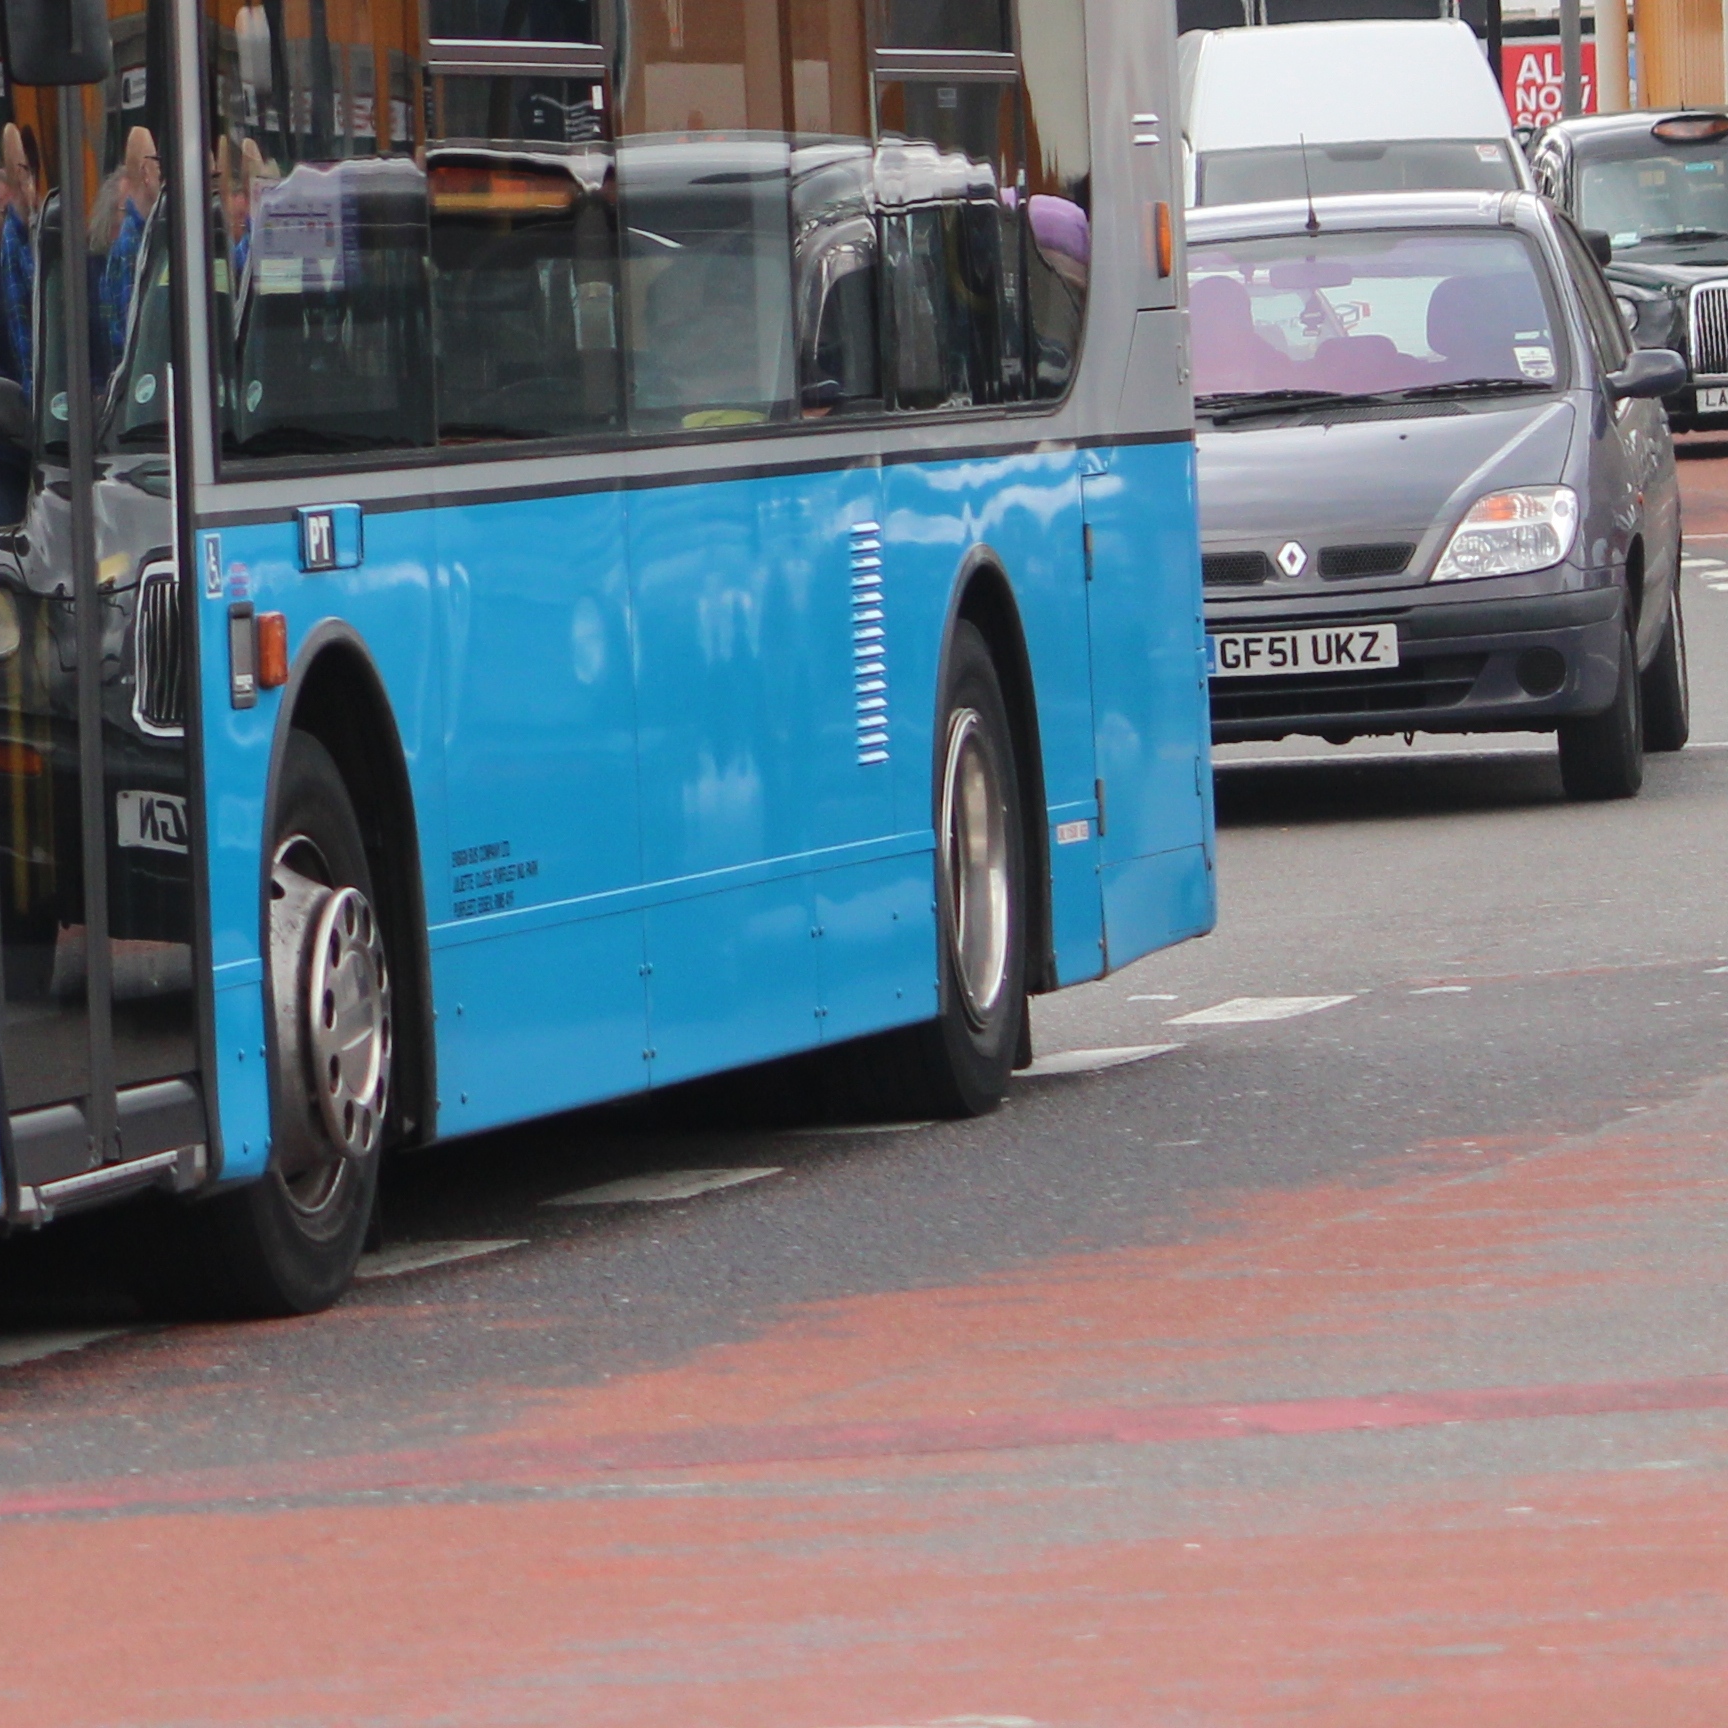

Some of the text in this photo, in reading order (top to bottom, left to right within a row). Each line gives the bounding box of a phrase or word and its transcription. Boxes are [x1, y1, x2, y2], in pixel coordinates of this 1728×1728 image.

[1516, 52, 1590, 84] AL
[1515, 85, 1591, 112] NO
[307, 515, 331, 562] PT
[1219, 631, 1381, 669] GF51 UKZ
